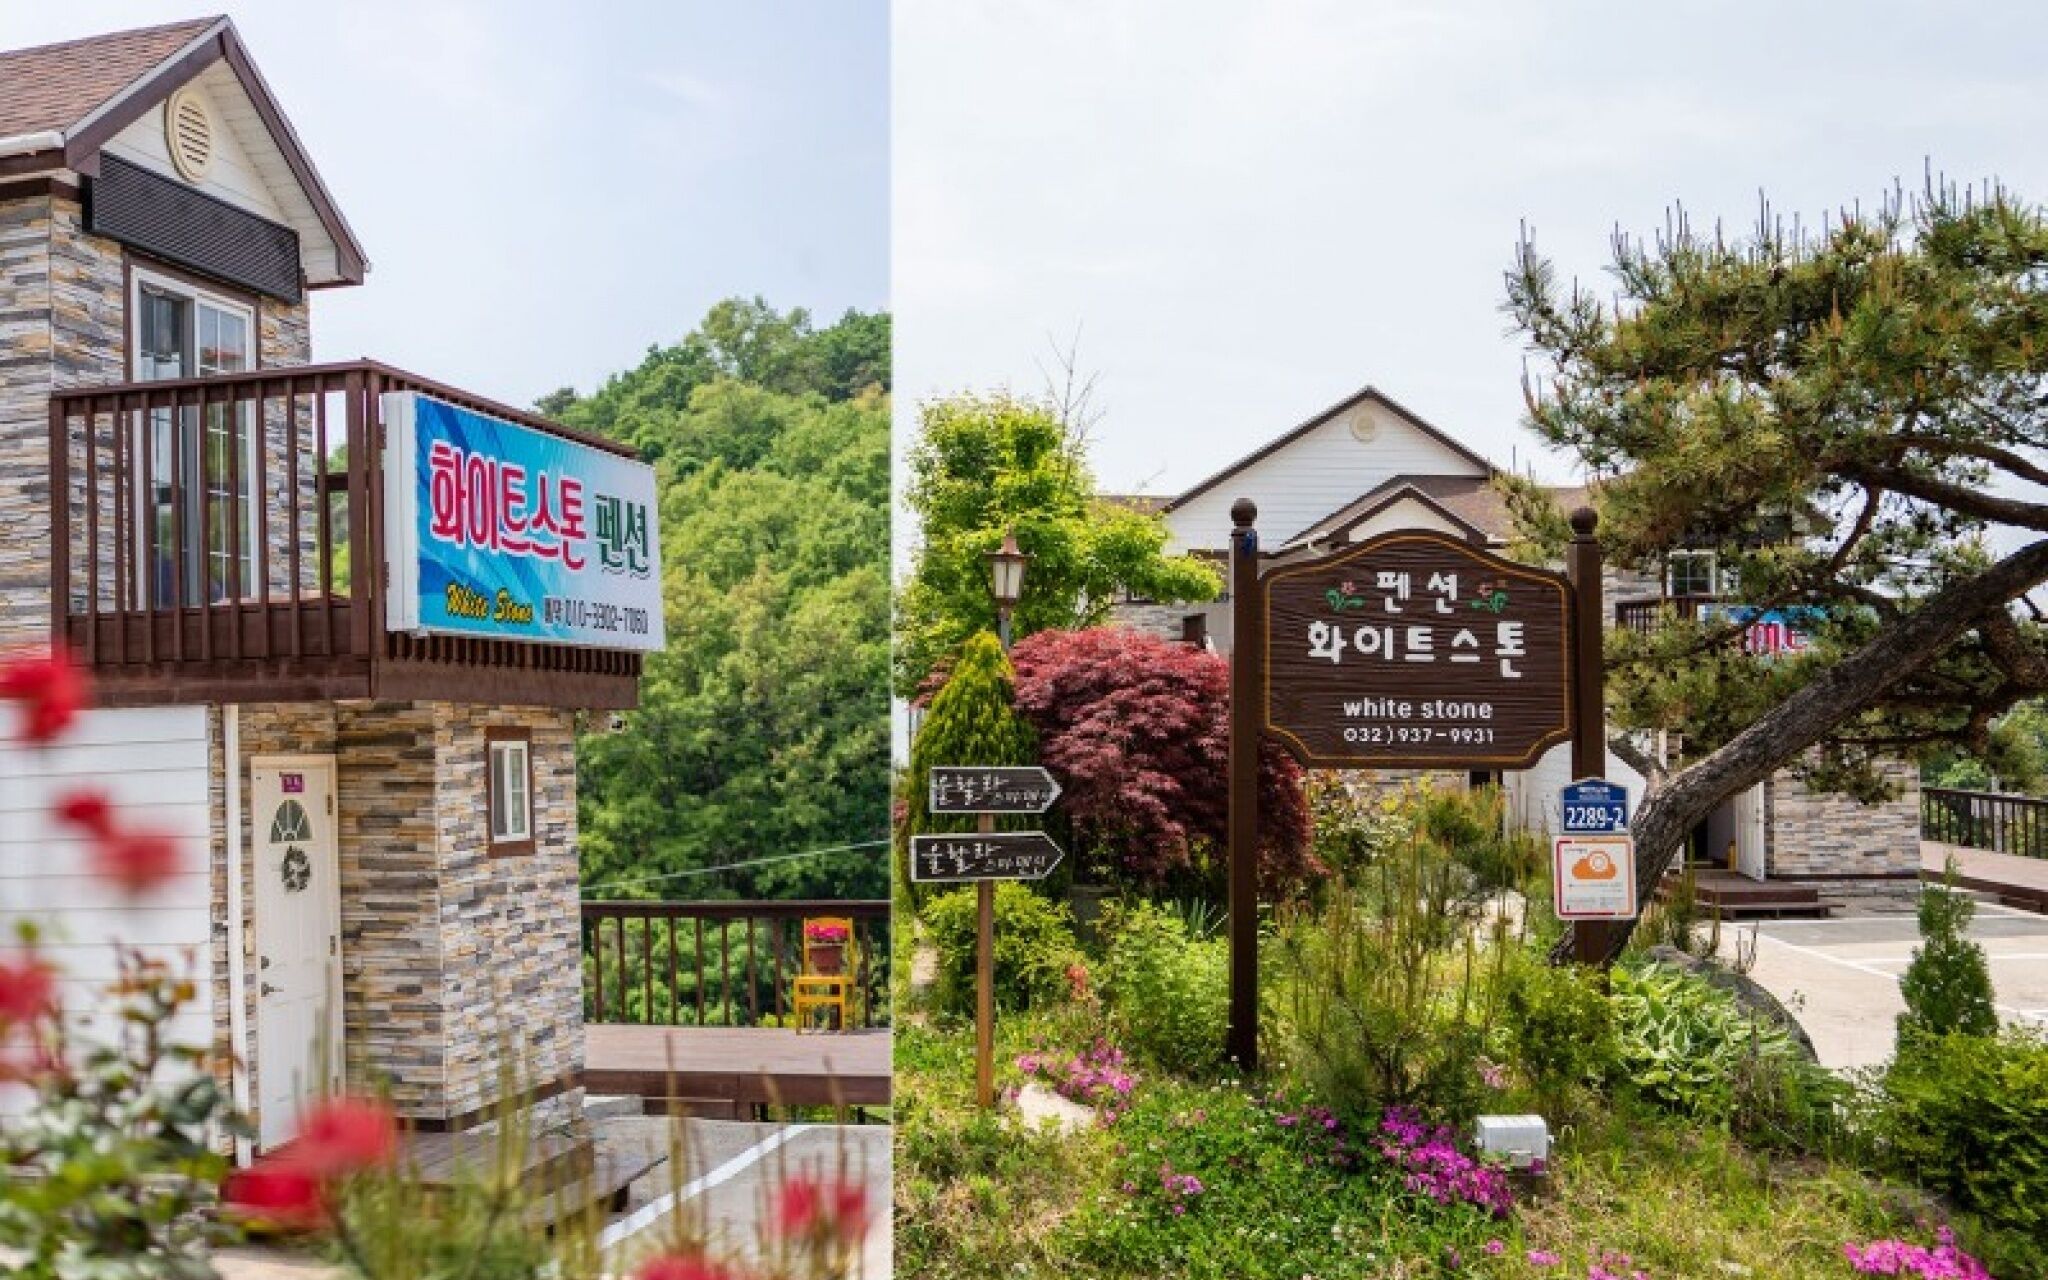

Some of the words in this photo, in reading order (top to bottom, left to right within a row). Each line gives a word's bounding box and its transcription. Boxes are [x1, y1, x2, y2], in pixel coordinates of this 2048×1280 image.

[431, 441, 587, 570] 화이트스톤
[594, 494, 649, 576] 펜션
[1343, 698, 1411, 719] white
[1420, 699, 1493, 719] stone
[1566, 806, 1624, 829] 2289-2
